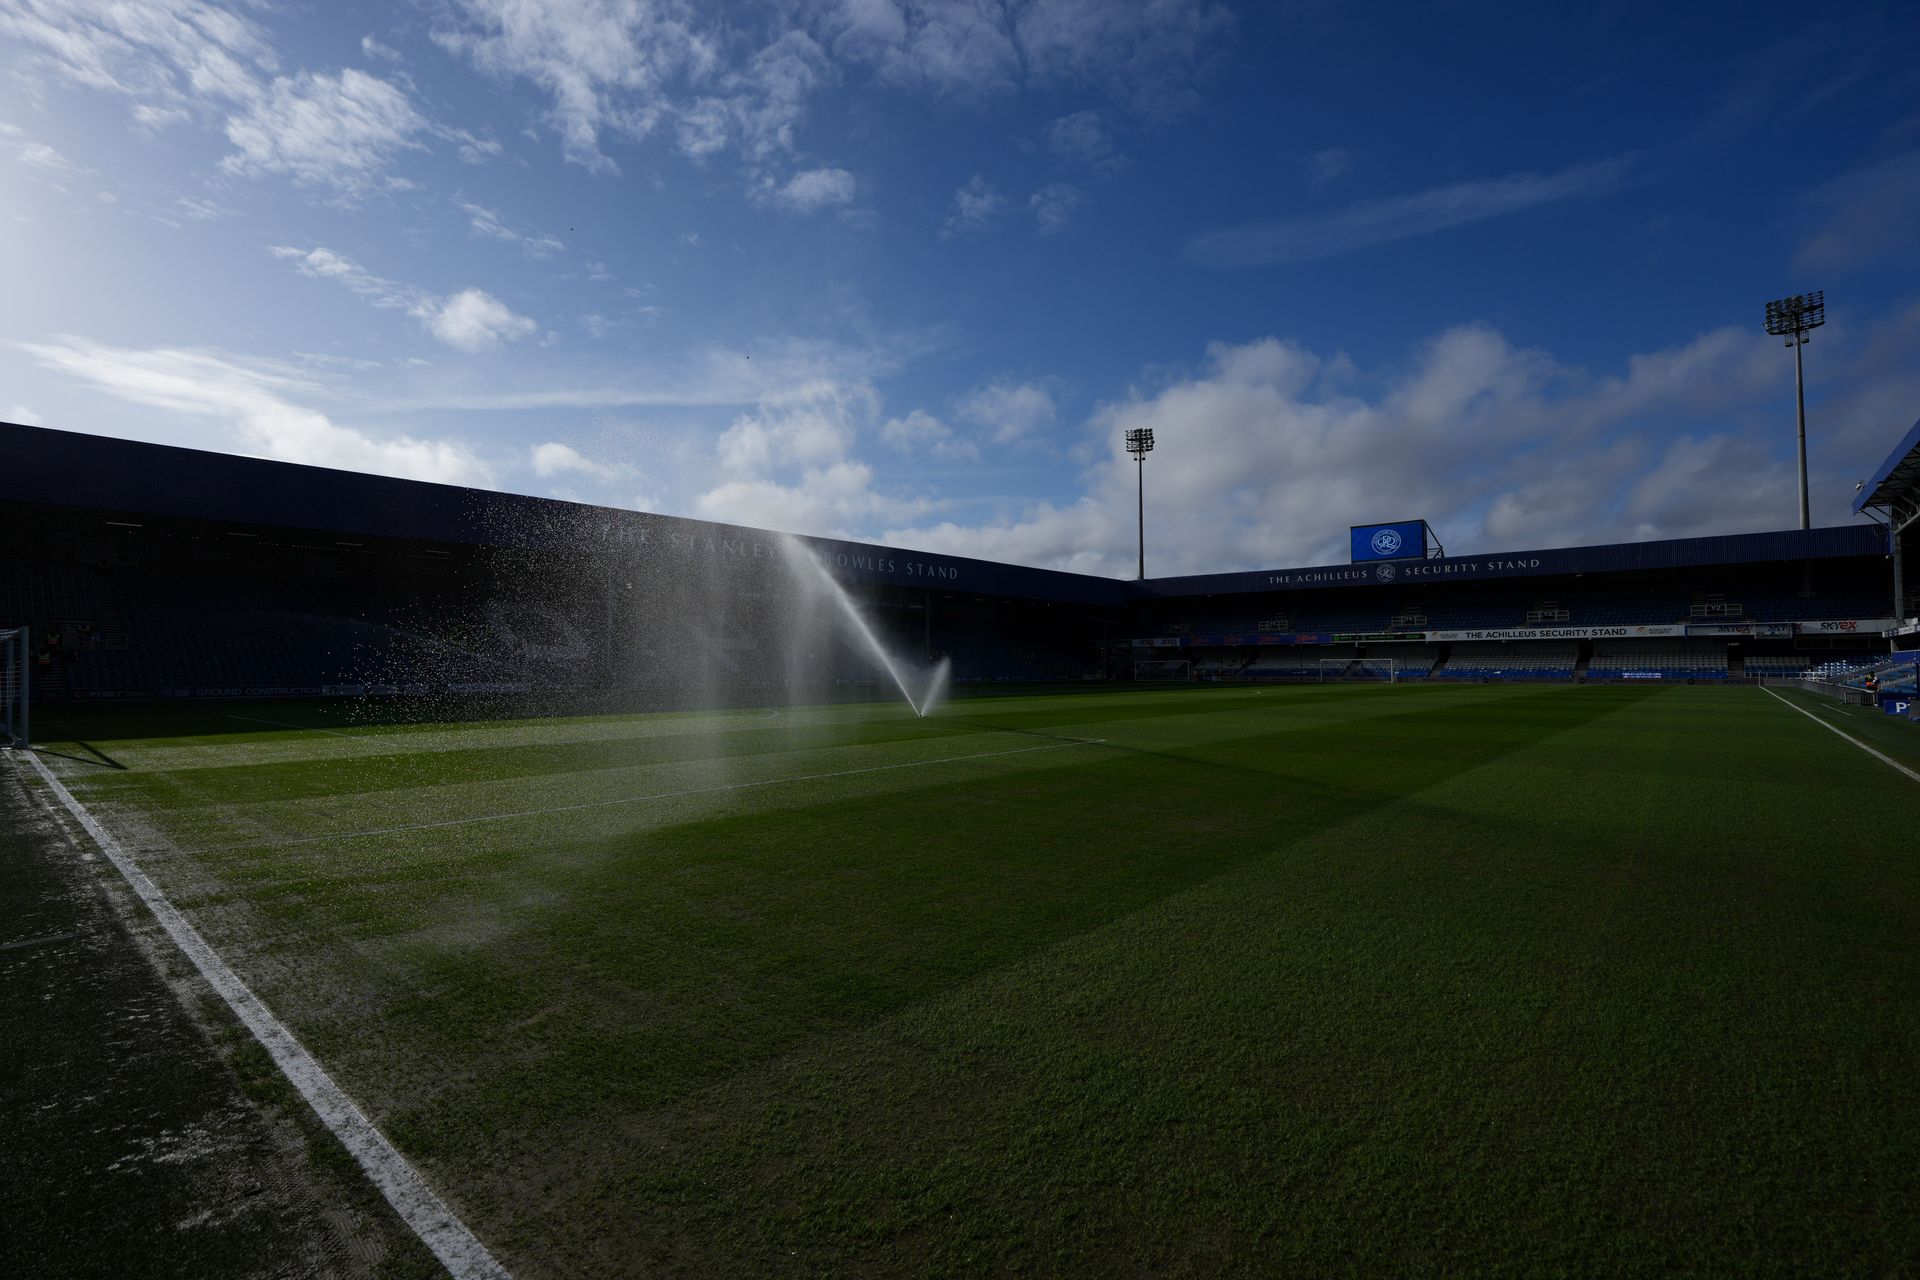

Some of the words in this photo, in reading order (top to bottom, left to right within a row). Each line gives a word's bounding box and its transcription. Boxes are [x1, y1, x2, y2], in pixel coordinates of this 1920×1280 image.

[907, 561, 959, 581] STAND
[1268, 575, 1291, 584] THE
[1296, 569, 1368, 583] ACHILLEUS
[1405, 562, 1478, 576] SECURITY
[1488, 559, 1541, 571] STAND
[1485, 630, 1537, 639] ACHILLEUS
[1539, 629, 1589, 637] SECURITY
[1591, 628, 1627, 636] STAND
[196, 688, 242, 696] GROUND
[245, 687, 320, 696] CONSTRUCTION
